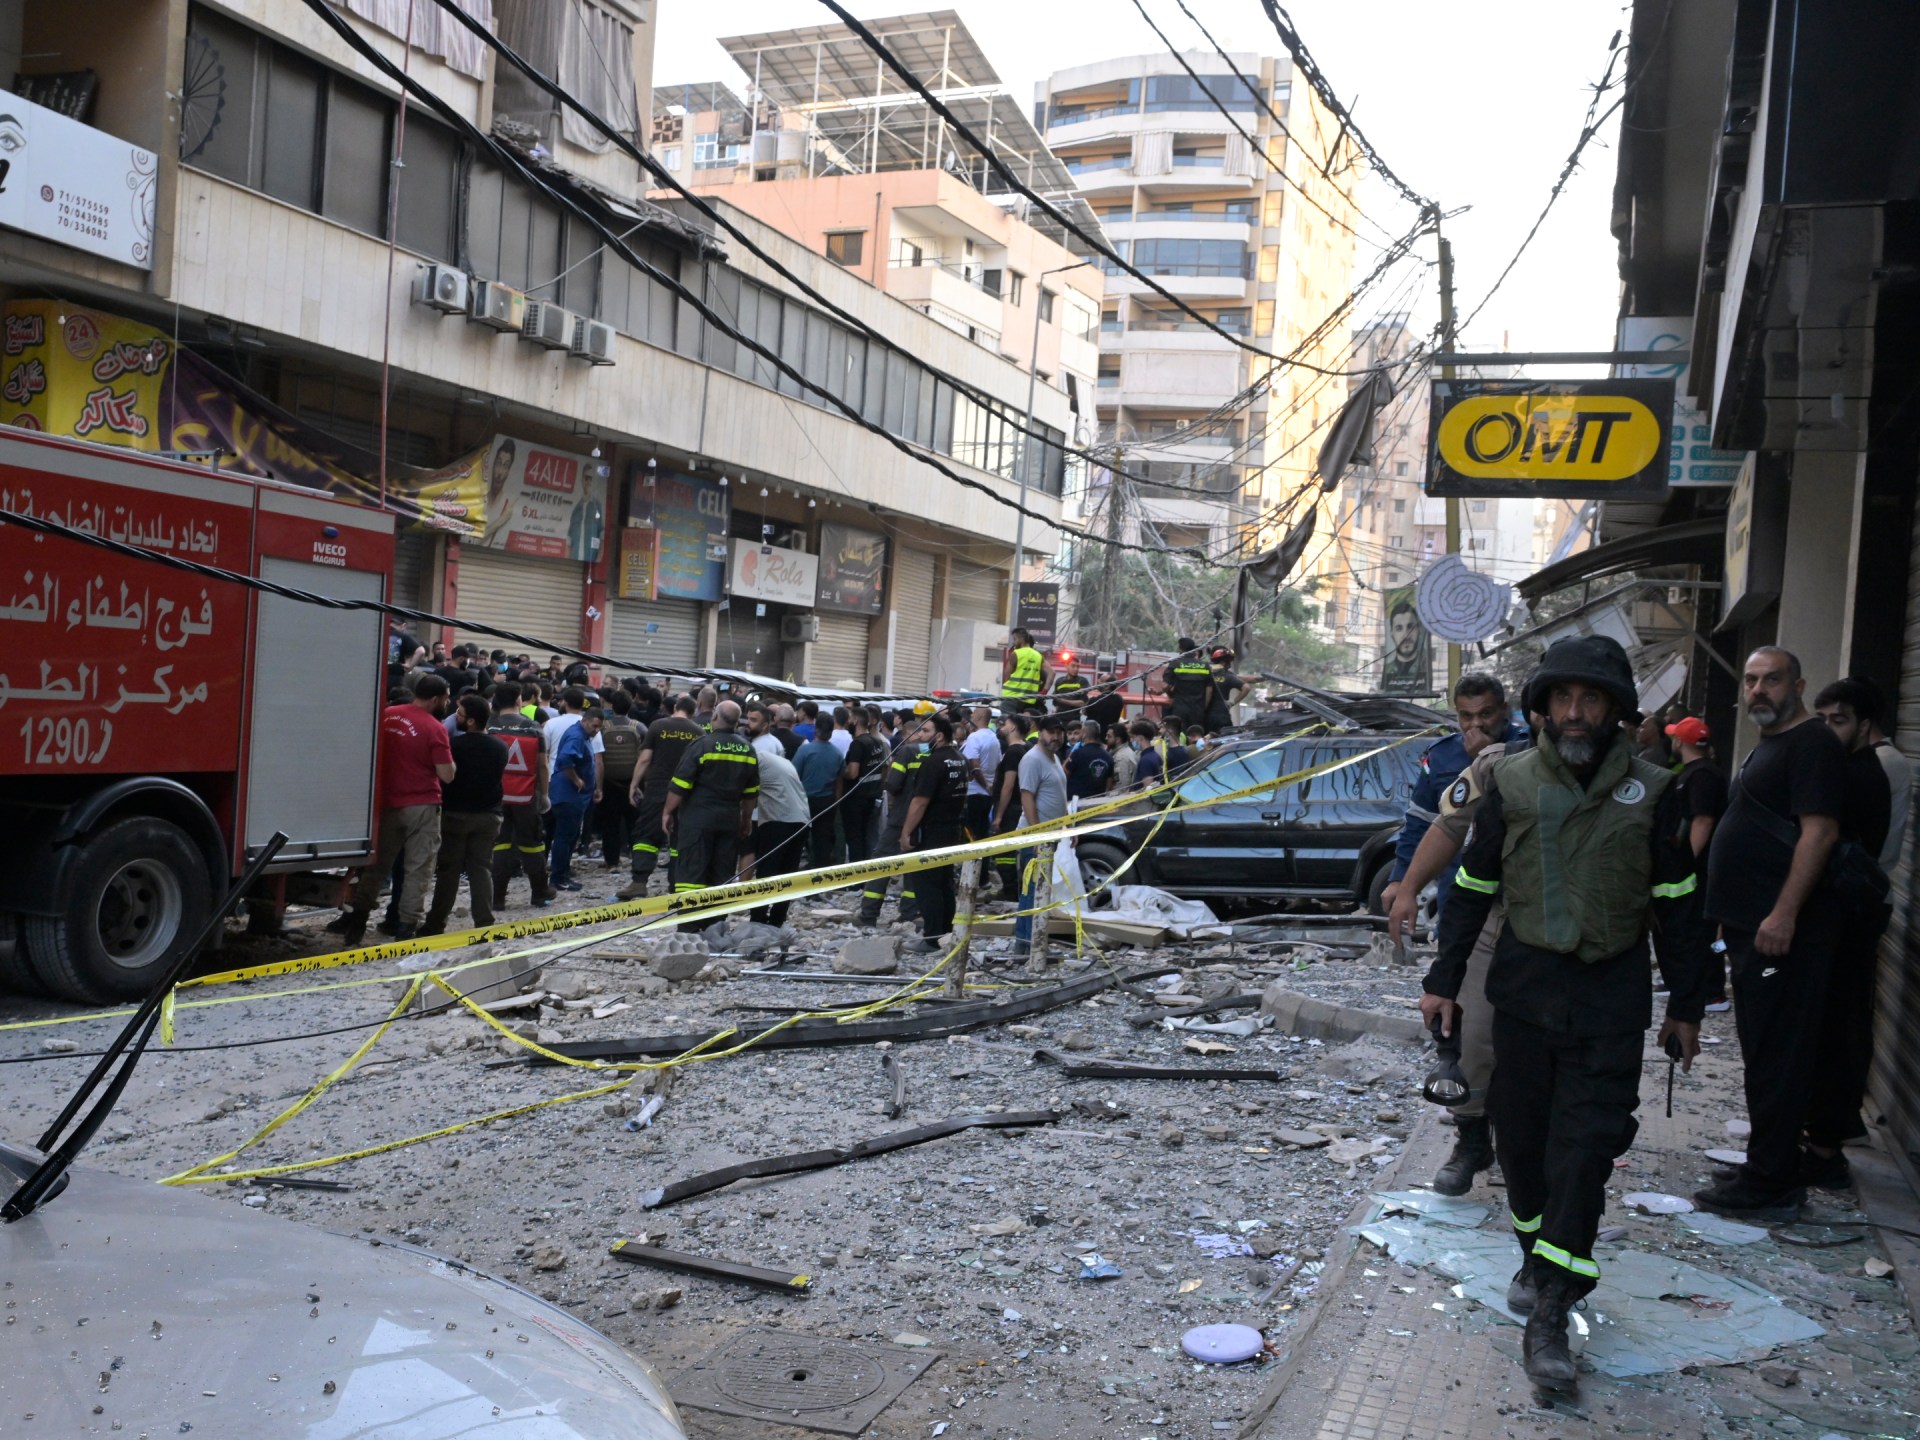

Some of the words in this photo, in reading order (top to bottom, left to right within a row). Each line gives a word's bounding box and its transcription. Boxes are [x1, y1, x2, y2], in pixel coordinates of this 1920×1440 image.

[58, 190, 109, 215] 71/575559
[58, 216, 107, 240] 70/336082
[76, 388, 148, 436] سكاكر
[1464, 411, 1632, 464] OMT
[529, 457, 572, 489] 4ALL
[312, 554, 346, 566] MAGIRUS
[313, 541, 347, 557] IVECO
[66, 574, 150, 646] إطفاء
[155, 588, 214, 650] فوج
[102, 664, 208, 715] مركز
